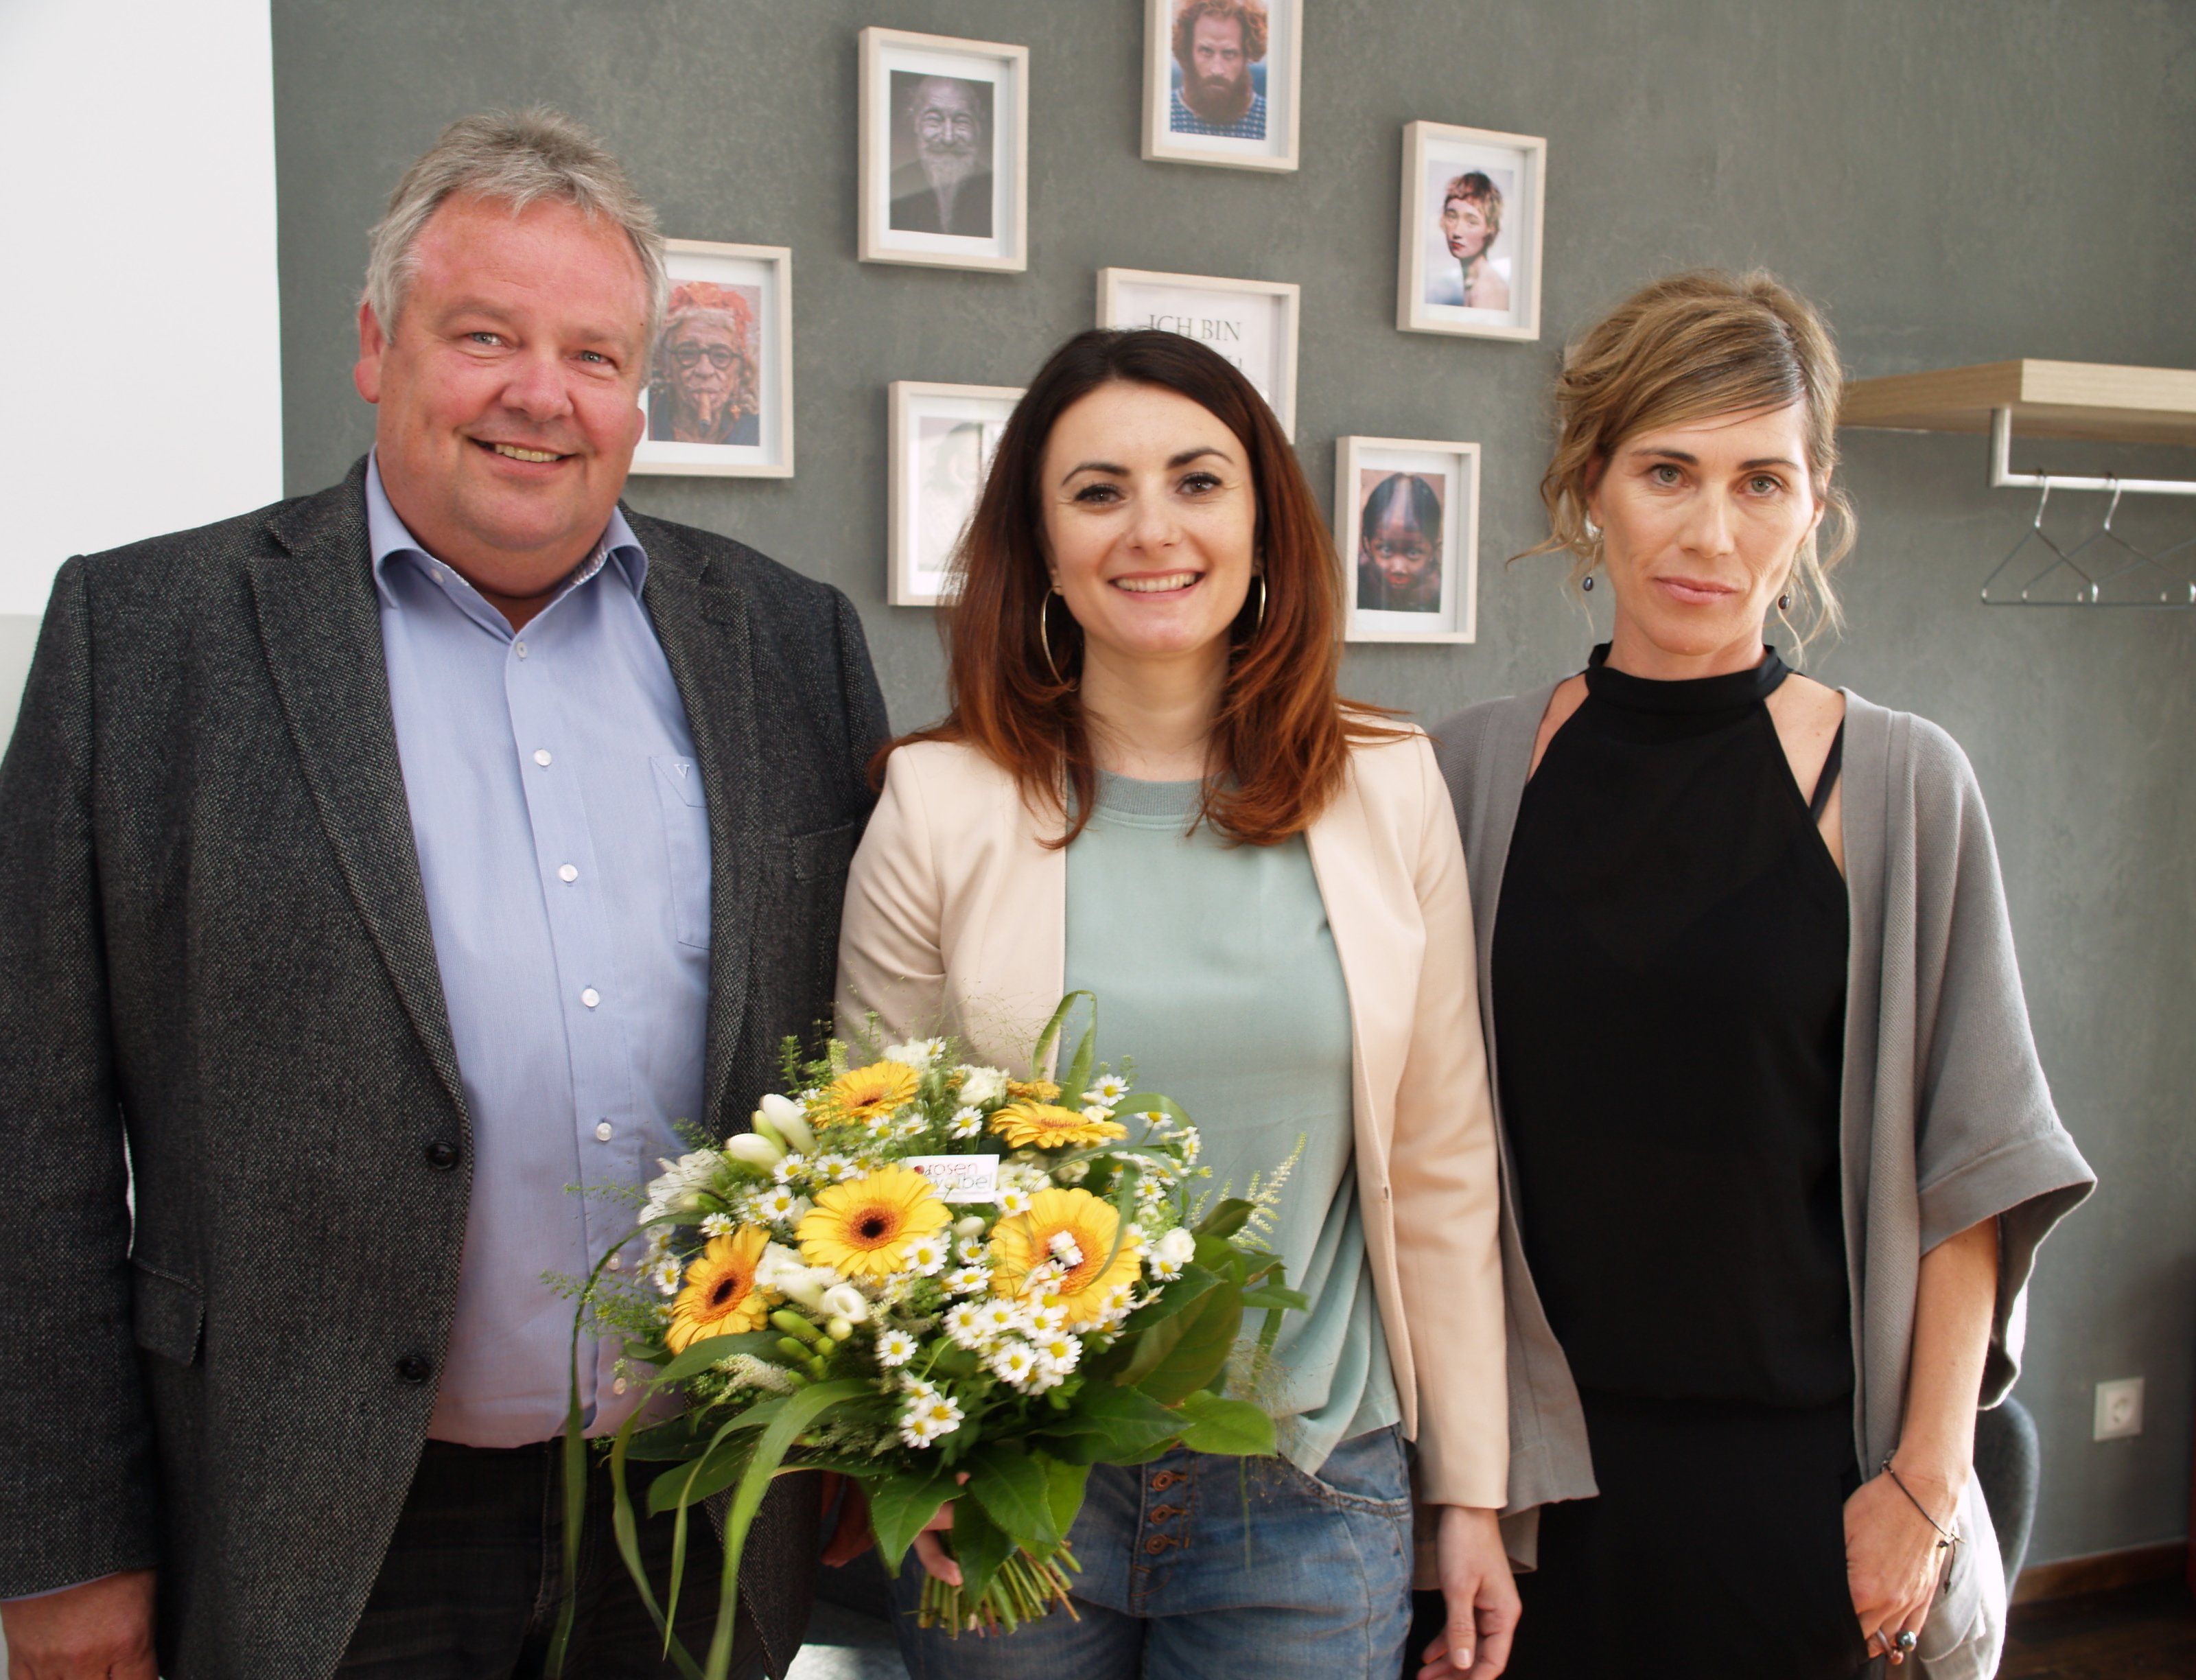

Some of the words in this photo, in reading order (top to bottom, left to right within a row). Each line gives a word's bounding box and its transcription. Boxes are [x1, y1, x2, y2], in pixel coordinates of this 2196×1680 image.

[1149, 314, 1193, 338] ICH
[1201, 319, 1241, 341] BIN
[928, 1163, 978, 1176] rosen
